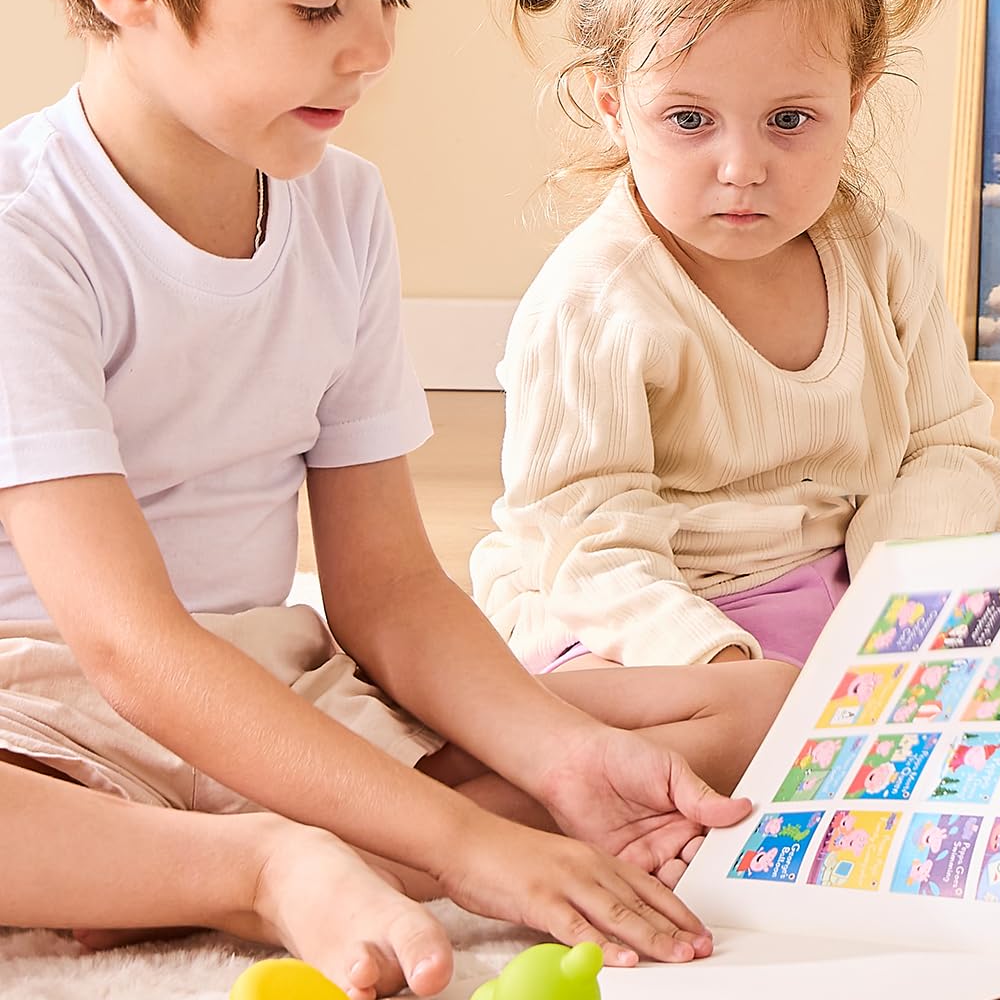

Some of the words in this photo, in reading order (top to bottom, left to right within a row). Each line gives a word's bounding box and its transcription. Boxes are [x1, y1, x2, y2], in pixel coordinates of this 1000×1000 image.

[771, 846, 791, 878] Balloon
[943, 841, 962, 883] Swimming
[956, 842, 972, 867] Peppa
